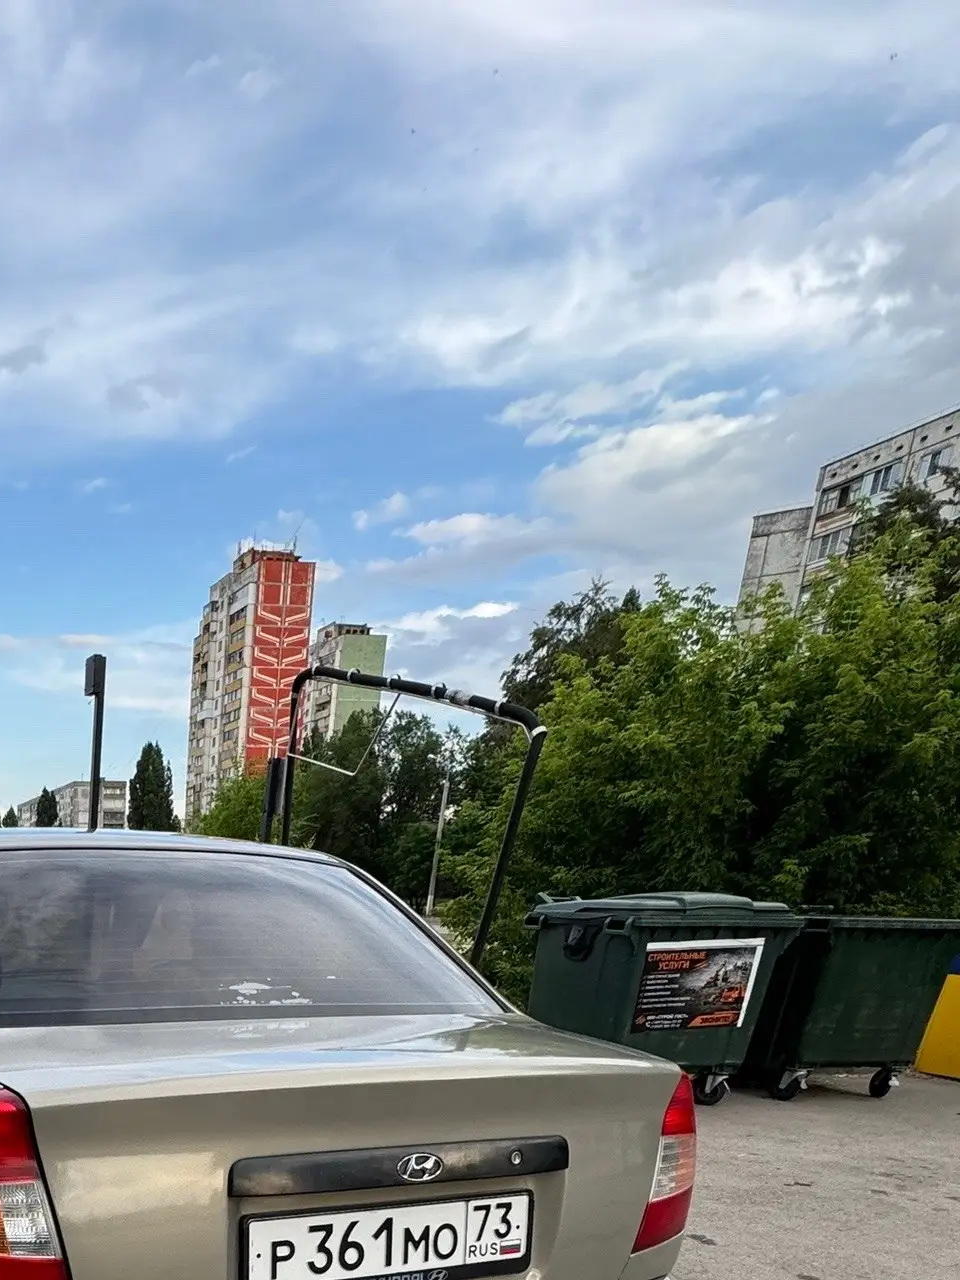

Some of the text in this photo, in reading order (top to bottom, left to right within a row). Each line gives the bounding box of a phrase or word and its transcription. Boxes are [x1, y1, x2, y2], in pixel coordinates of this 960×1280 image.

[647, 951, 707, 962] СТРОИТЕЛЬНЫЕ
[658, 960, 690, 970] УСЛУГИ
[473, 1202, 512, 1242] 73
[469, 1242, 499, 1258] RUS
